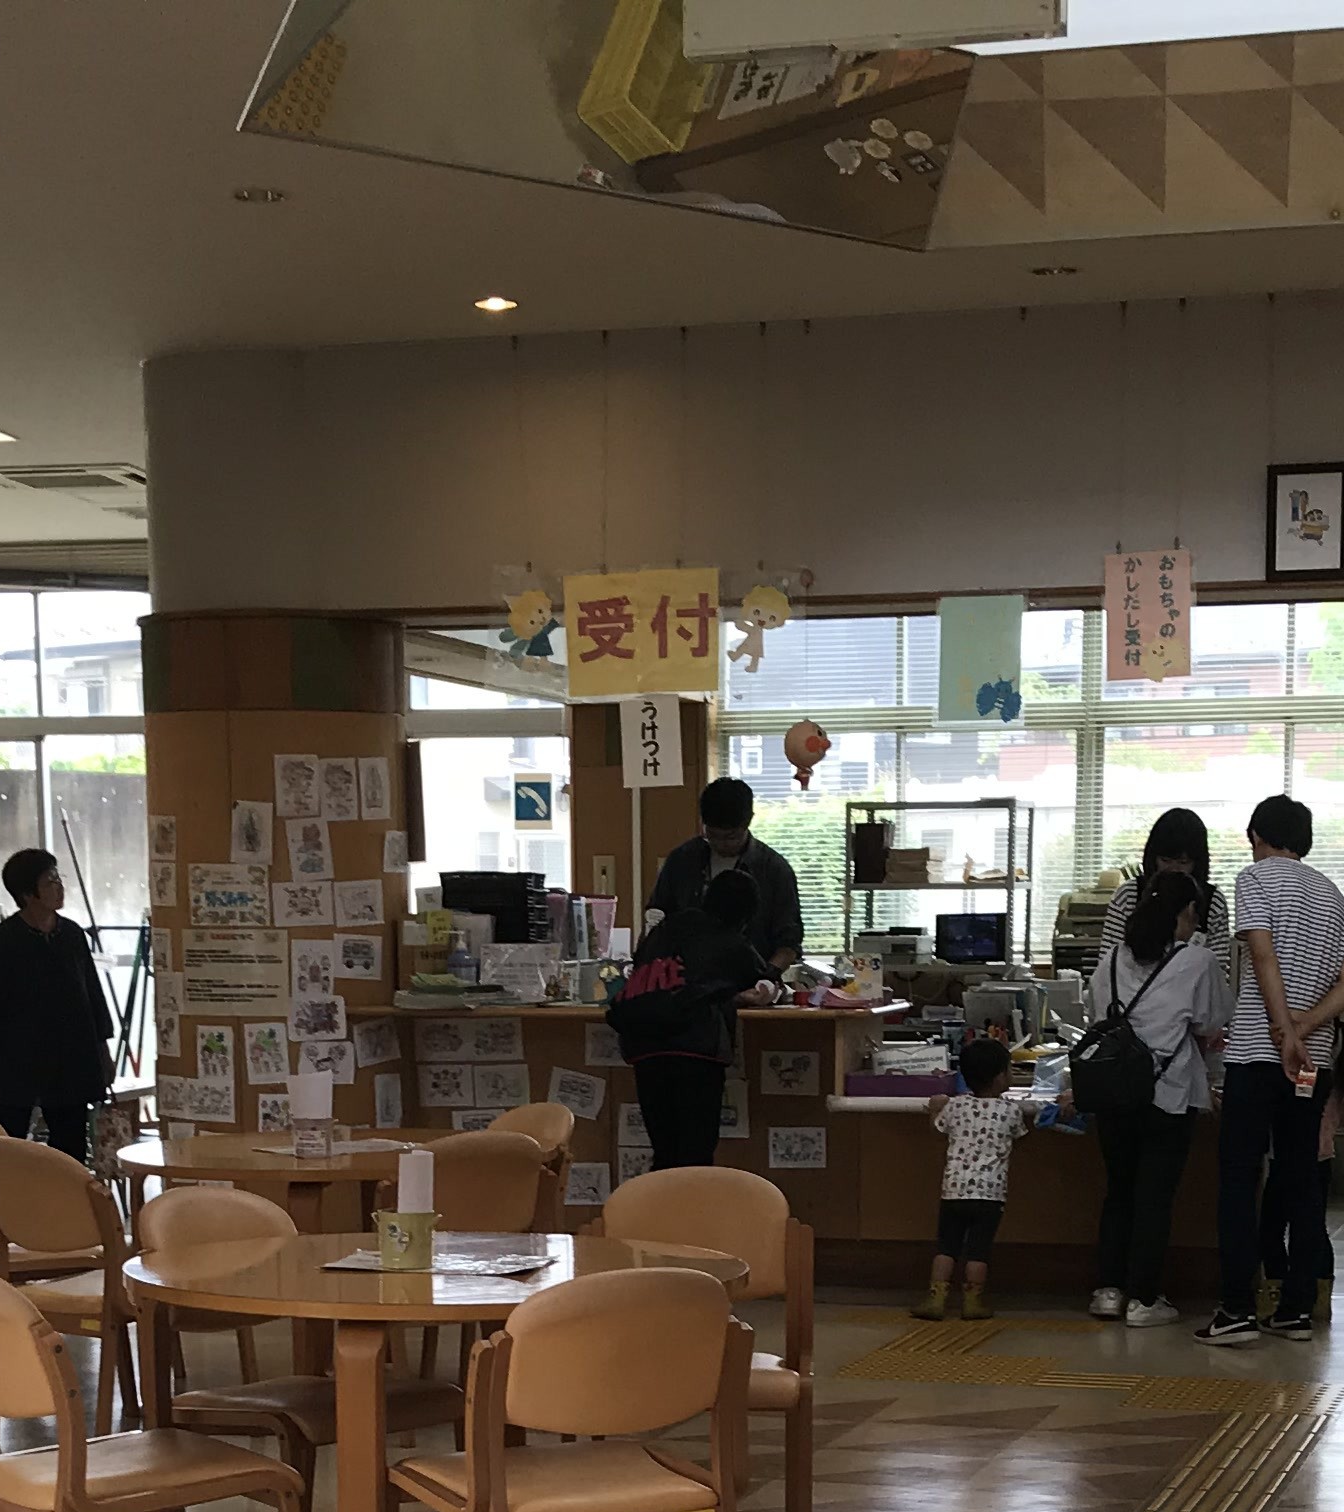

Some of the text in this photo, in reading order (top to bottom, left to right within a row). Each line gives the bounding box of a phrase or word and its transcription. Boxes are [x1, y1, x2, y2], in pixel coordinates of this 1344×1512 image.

[577, 593, 718, 663] 受付
[1158, 555, 1181, 638] おもちゃの
[640, 701, 661, 777] うけつけ
